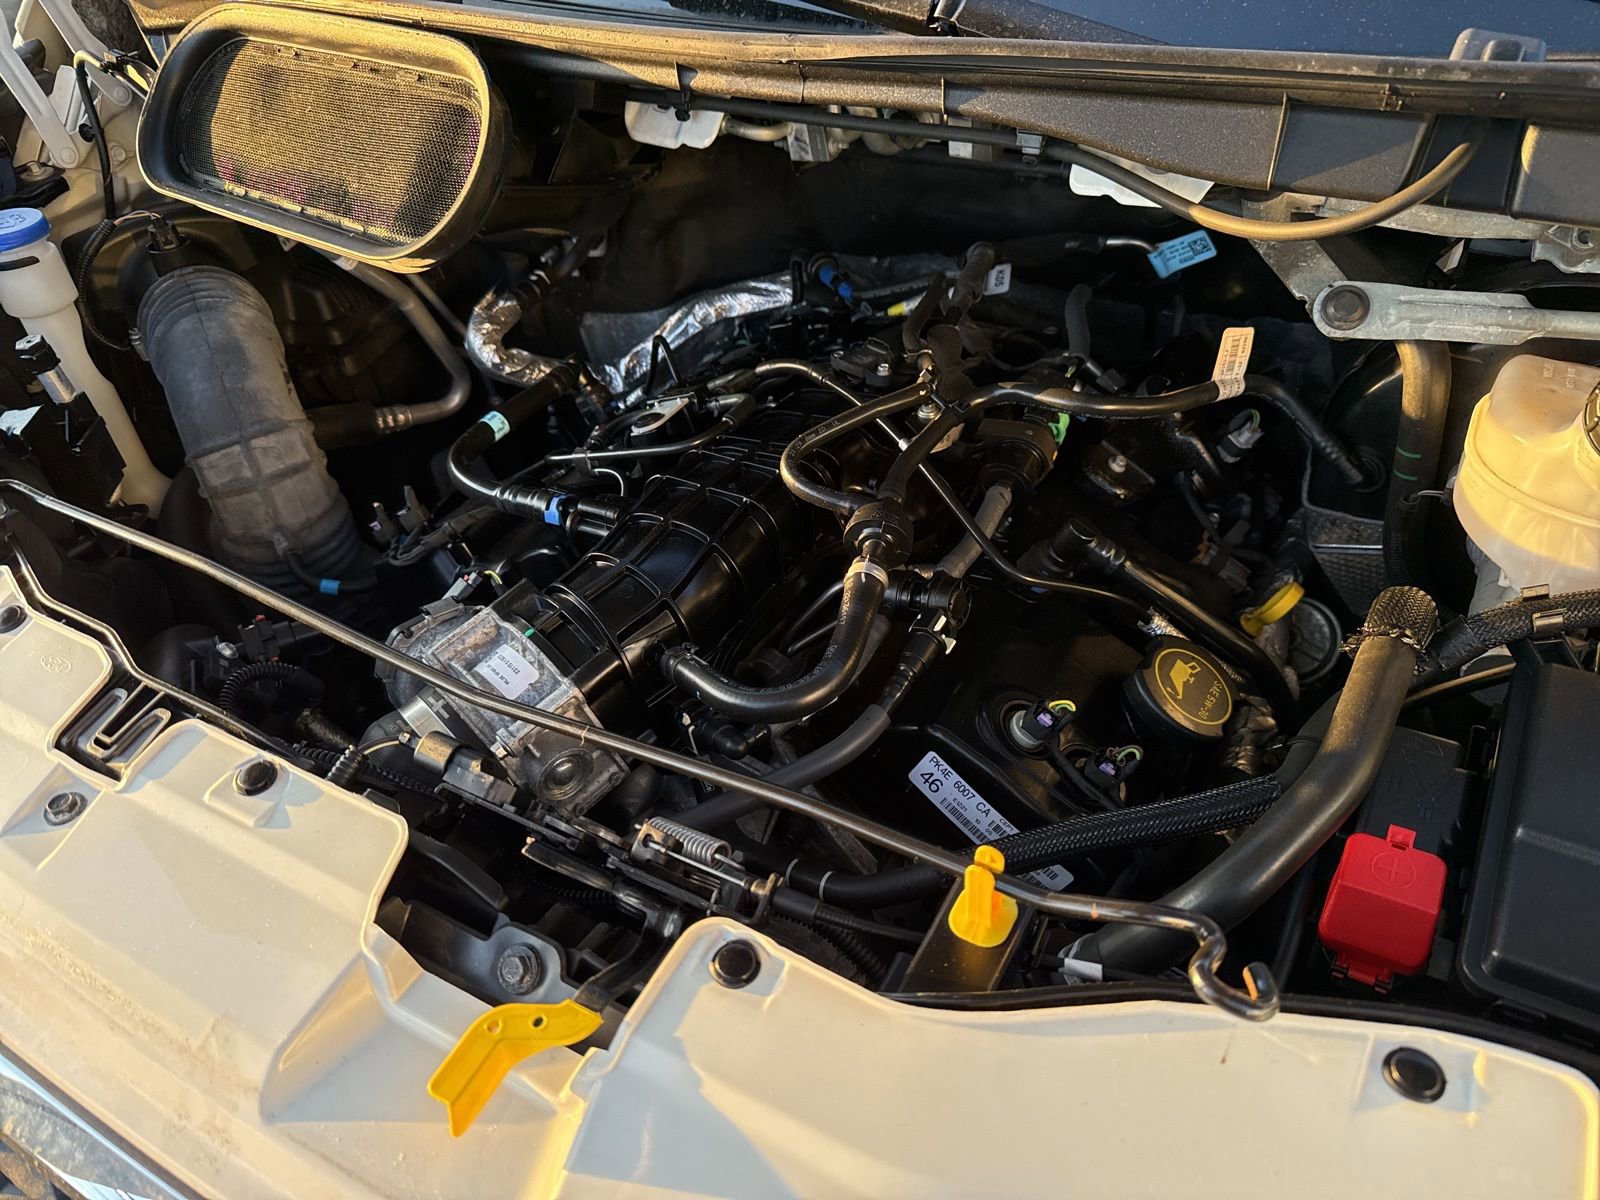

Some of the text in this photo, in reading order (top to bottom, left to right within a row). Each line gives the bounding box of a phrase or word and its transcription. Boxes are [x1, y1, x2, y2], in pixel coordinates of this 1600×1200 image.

[1209, 680, 1222, 698] SAE
[919, 771, 944, 794] 46
[928, 755, 991, 818] PK4E 6007 CA
